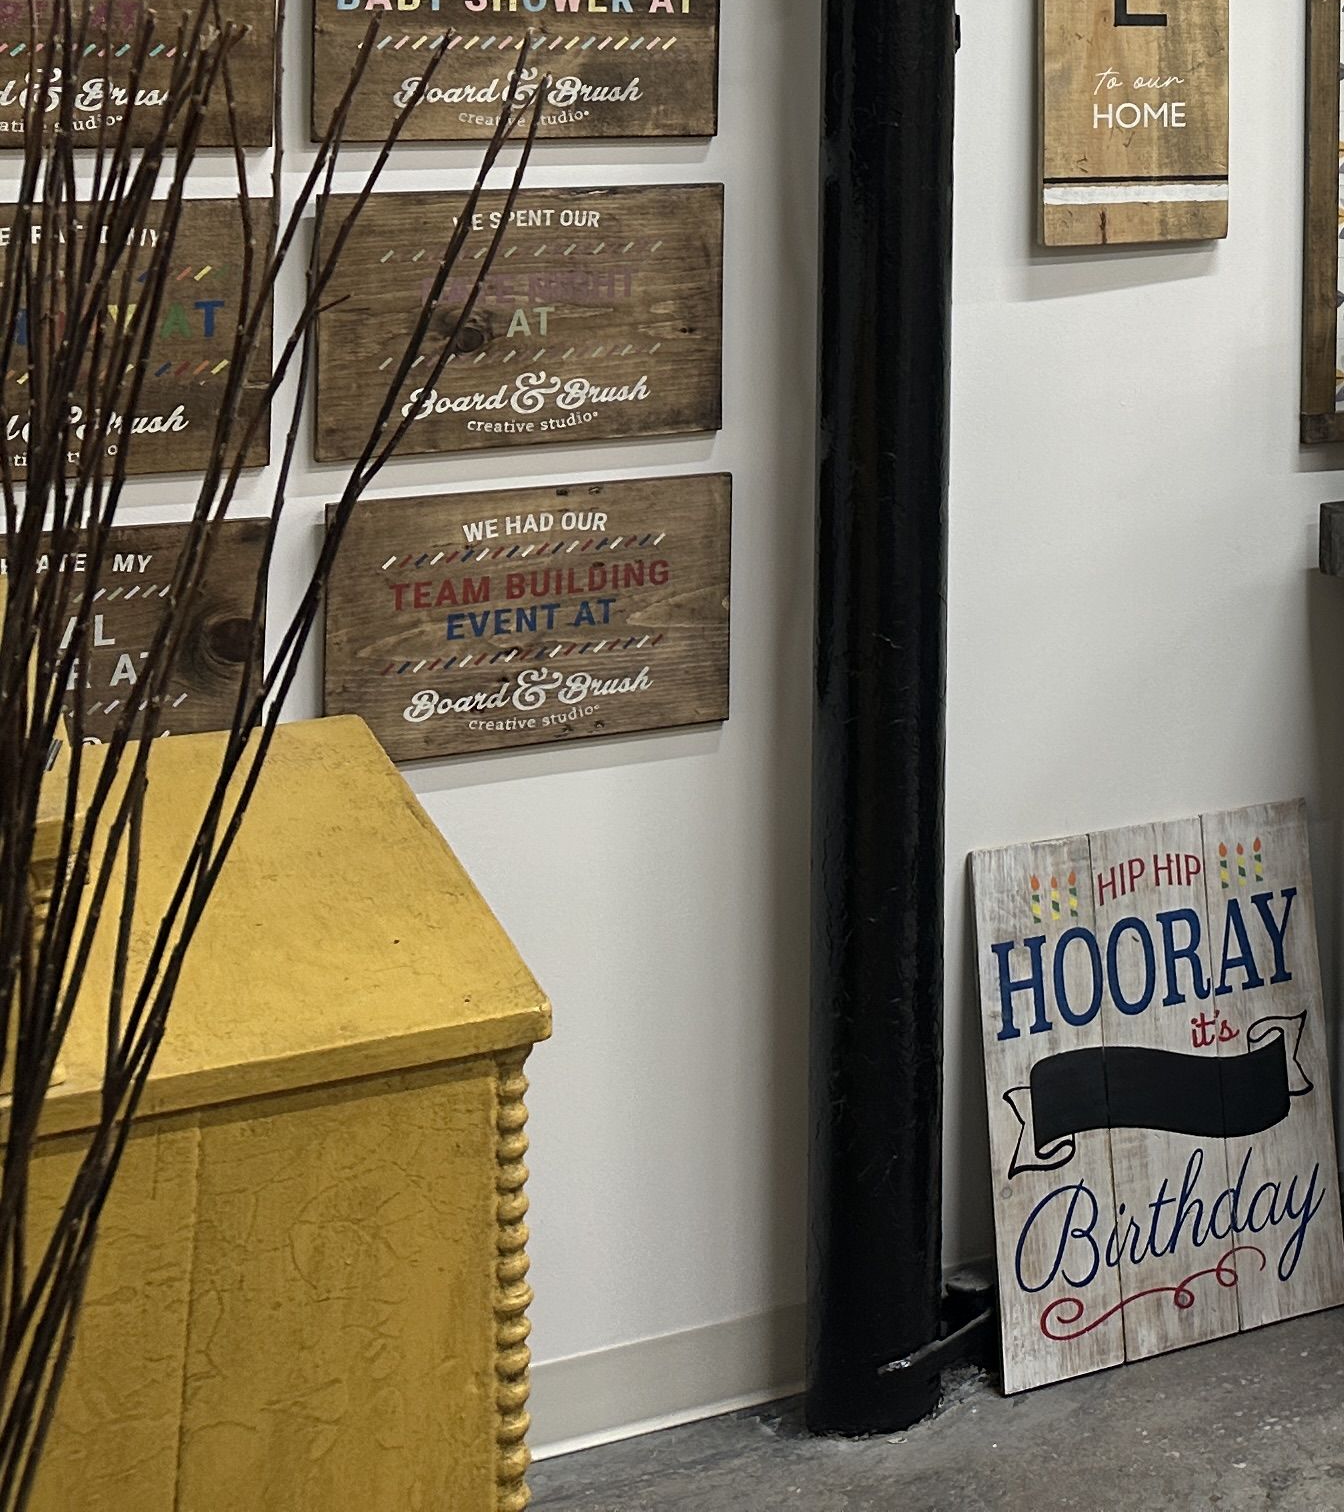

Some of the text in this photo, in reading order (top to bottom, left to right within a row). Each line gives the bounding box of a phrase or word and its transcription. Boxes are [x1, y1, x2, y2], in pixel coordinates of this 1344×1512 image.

[393, 76, 501, 109] Board
[547, 77, 644, 108] Brush
[1093, 66, 1185, 96] to our
[458, 109, 583, 128] creatve tudio
[1093, 101, 1187, 129] HOME
[560, 209, 600, 229] OUR
[506, 306, 556, 338] AT
[401, 371, 651, 420] Board & Brush
[467, 419, 534, 433] creative
[463, 511, 608, 542] WE HAD OUR
[112, 554, 152, 573] MY
[389, 559, 670, 612] TEAM BUILDING
[446, 598, 617, 640] EVENT AT
[402, 665, 654, 723] Board & Brush
[468, 717, 537, 732] creative
[1098, 851, 1202, 906] HIP HIP
[991, 886, 1298, 1042] HOORAY
[1190, 1008, 1240, 1049] it's
[1014, 1145, 1327, 1295] Birthday
